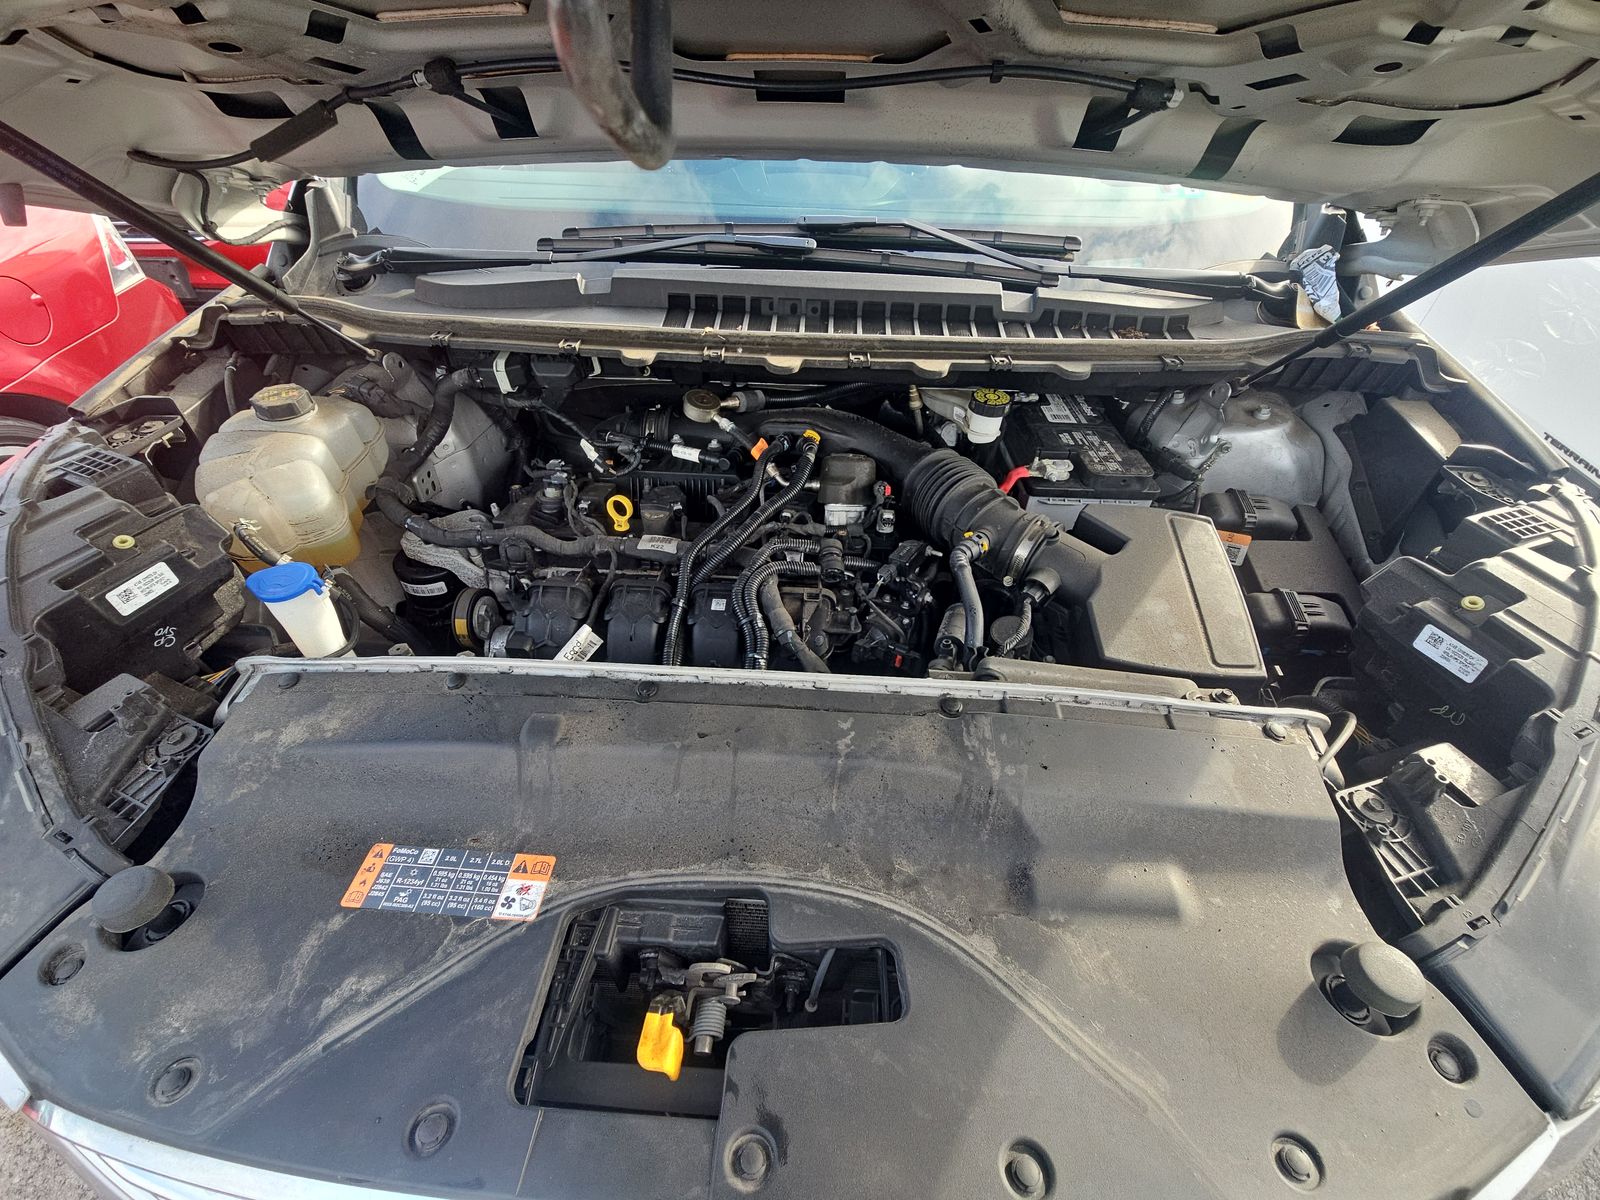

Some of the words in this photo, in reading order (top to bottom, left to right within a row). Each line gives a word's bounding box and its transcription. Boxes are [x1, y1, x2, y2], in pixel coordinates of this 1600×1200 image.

[392, 847, 419, 855] FoMoCo
[386, 855, 407, 863] (GWP
[395, 878, 424, 887] R-1234yf
